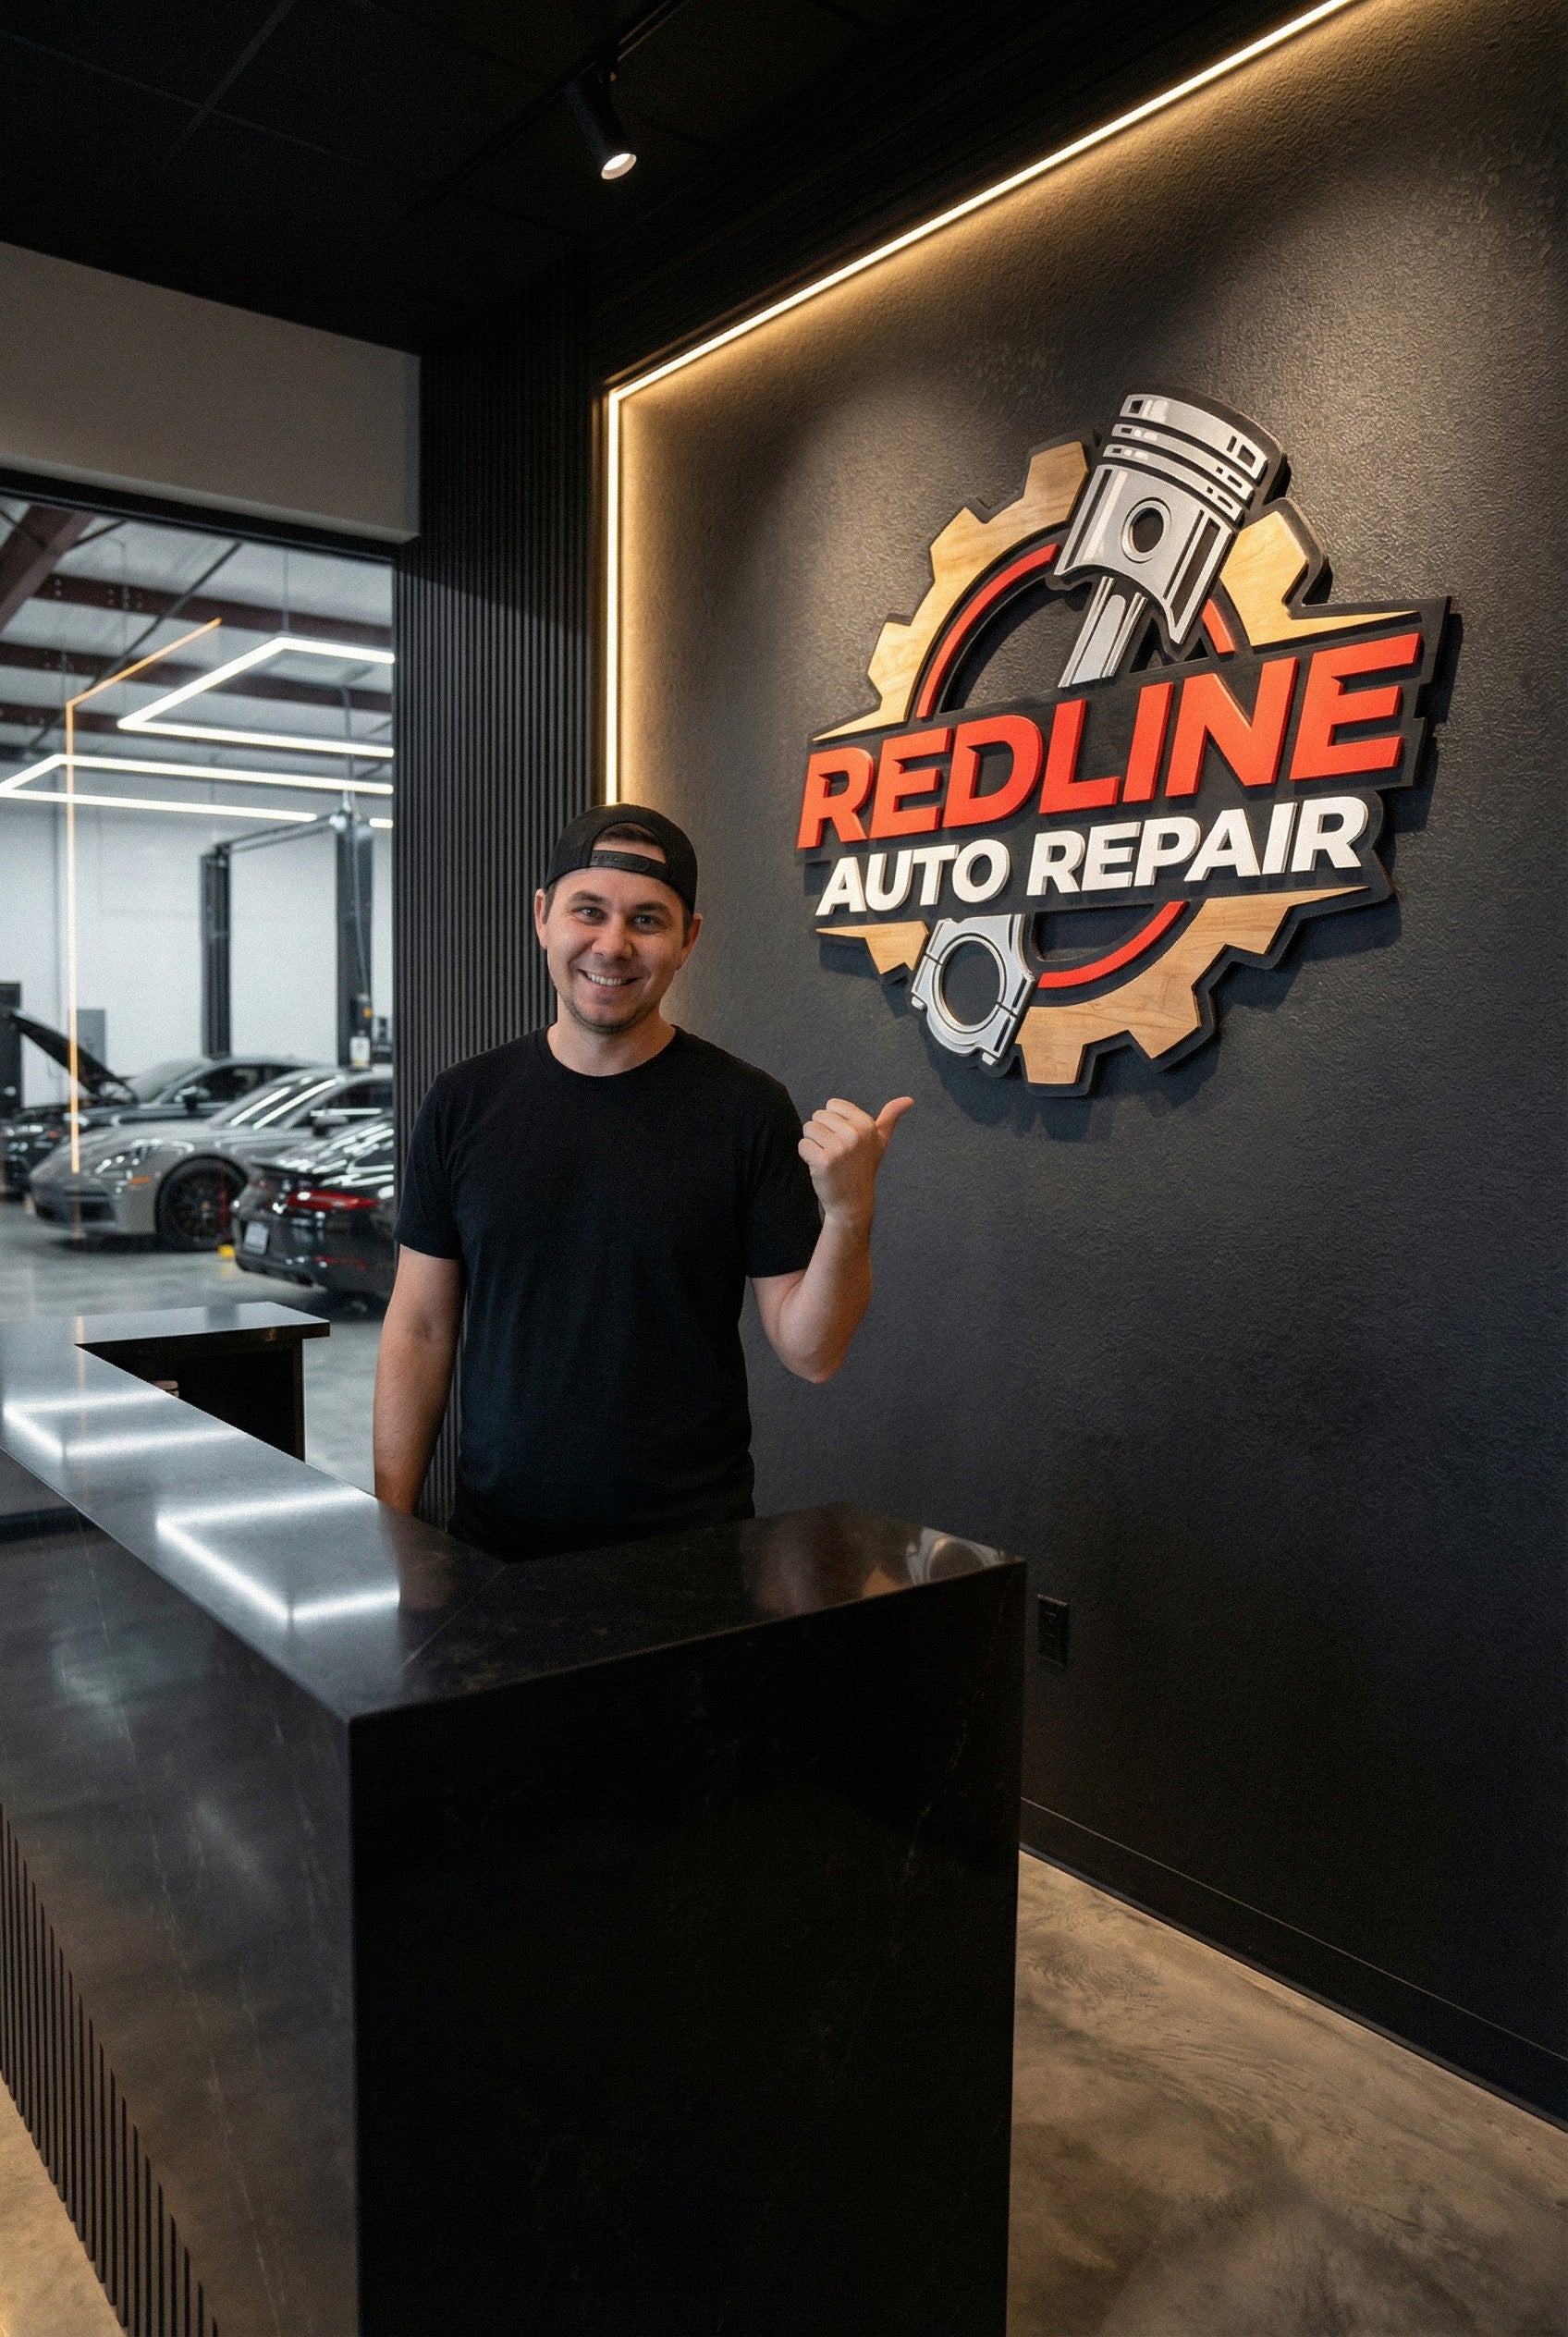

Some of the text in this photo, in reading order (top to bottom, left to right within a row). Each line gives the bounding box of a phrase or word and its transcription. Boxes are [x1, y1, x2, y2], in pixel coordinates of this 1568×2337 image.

[796, 632, 1421, 850] REDLINE
[815, 795, 1369, 916] AUTO REPAIR
